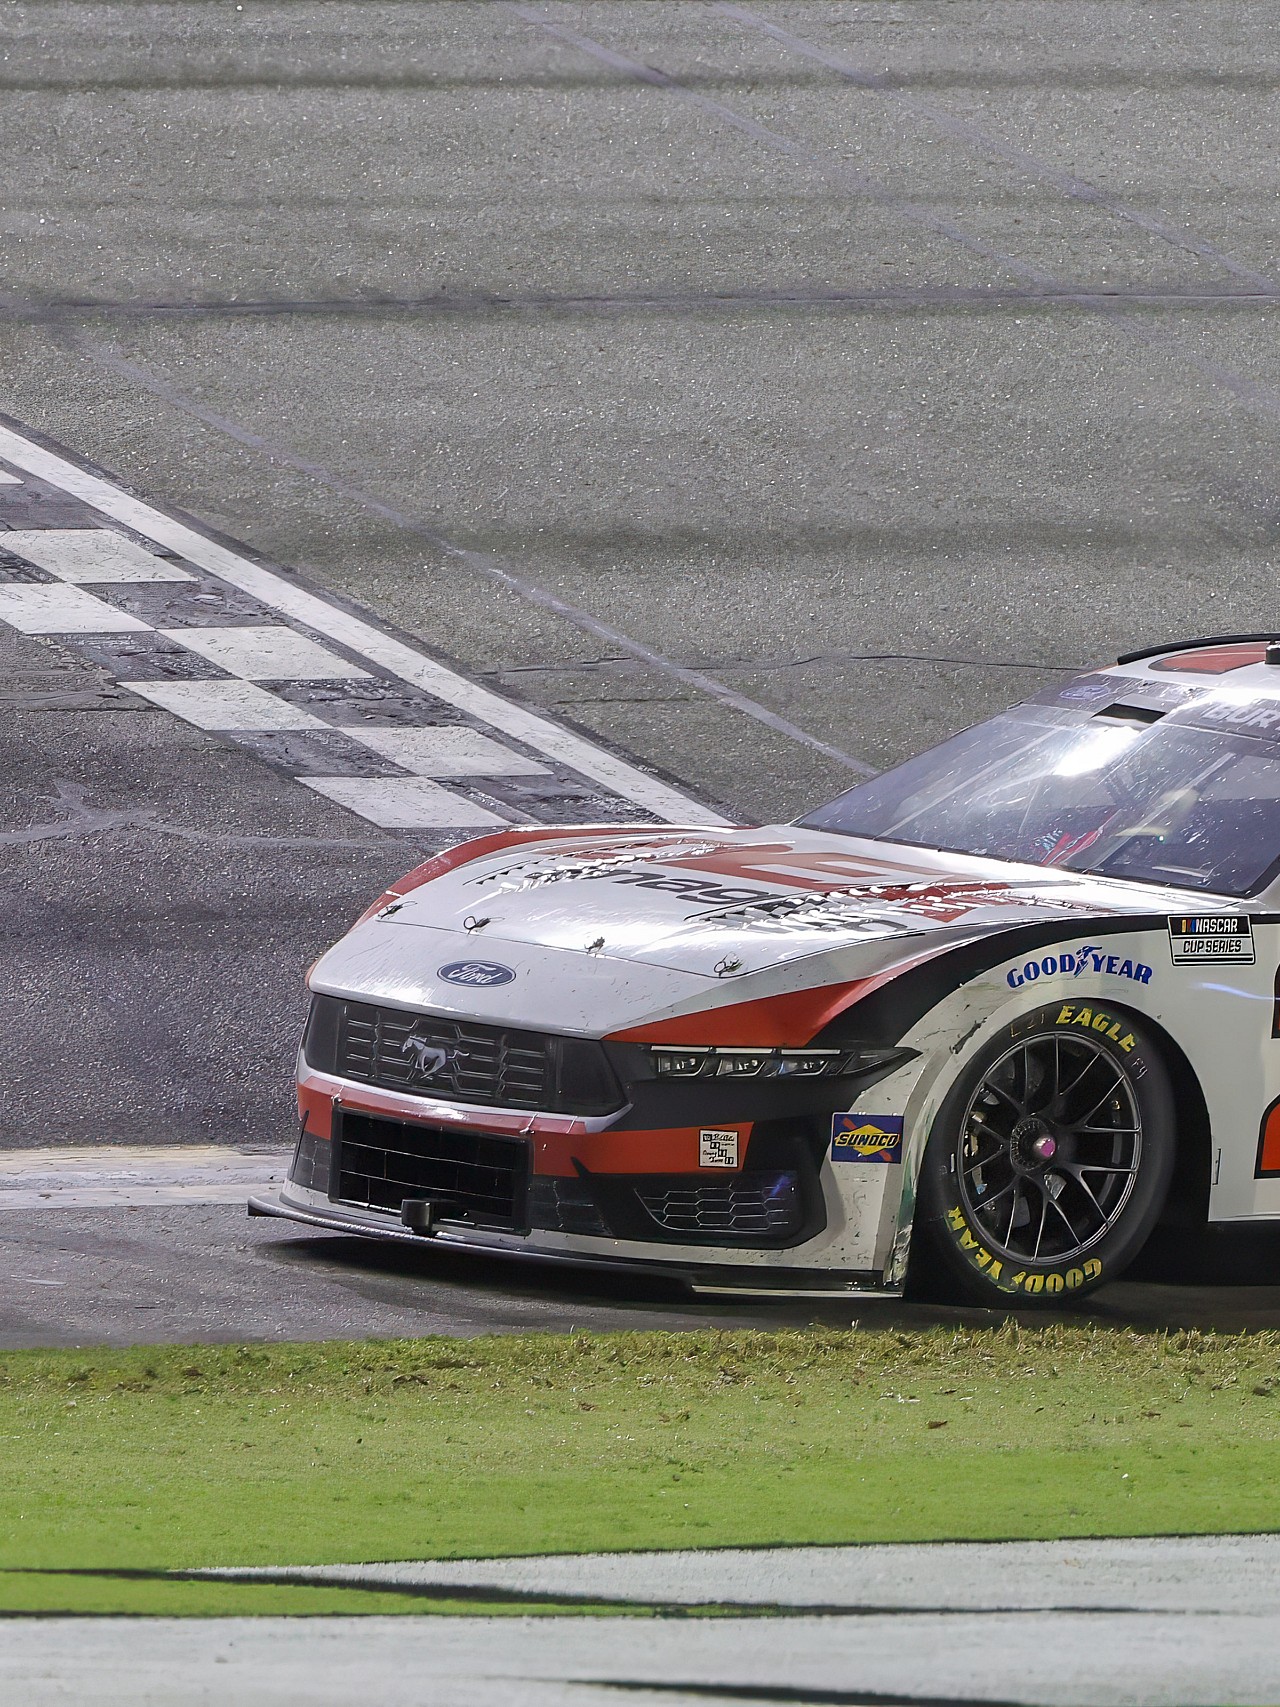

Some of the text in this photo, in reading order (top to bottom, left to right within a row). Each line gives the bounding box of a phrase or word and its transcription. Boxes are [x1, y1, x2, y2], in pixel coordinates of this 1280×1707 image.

[1195, 918, 1238, 934] NASCAR
[1183, 939, 1241, 953] CUP SERIES
[447, 963, 503, 985] Ford
[1055, 1004, 1137, 1053] EAGLE
[836, 1132, 900, 1147] SUNOCO
